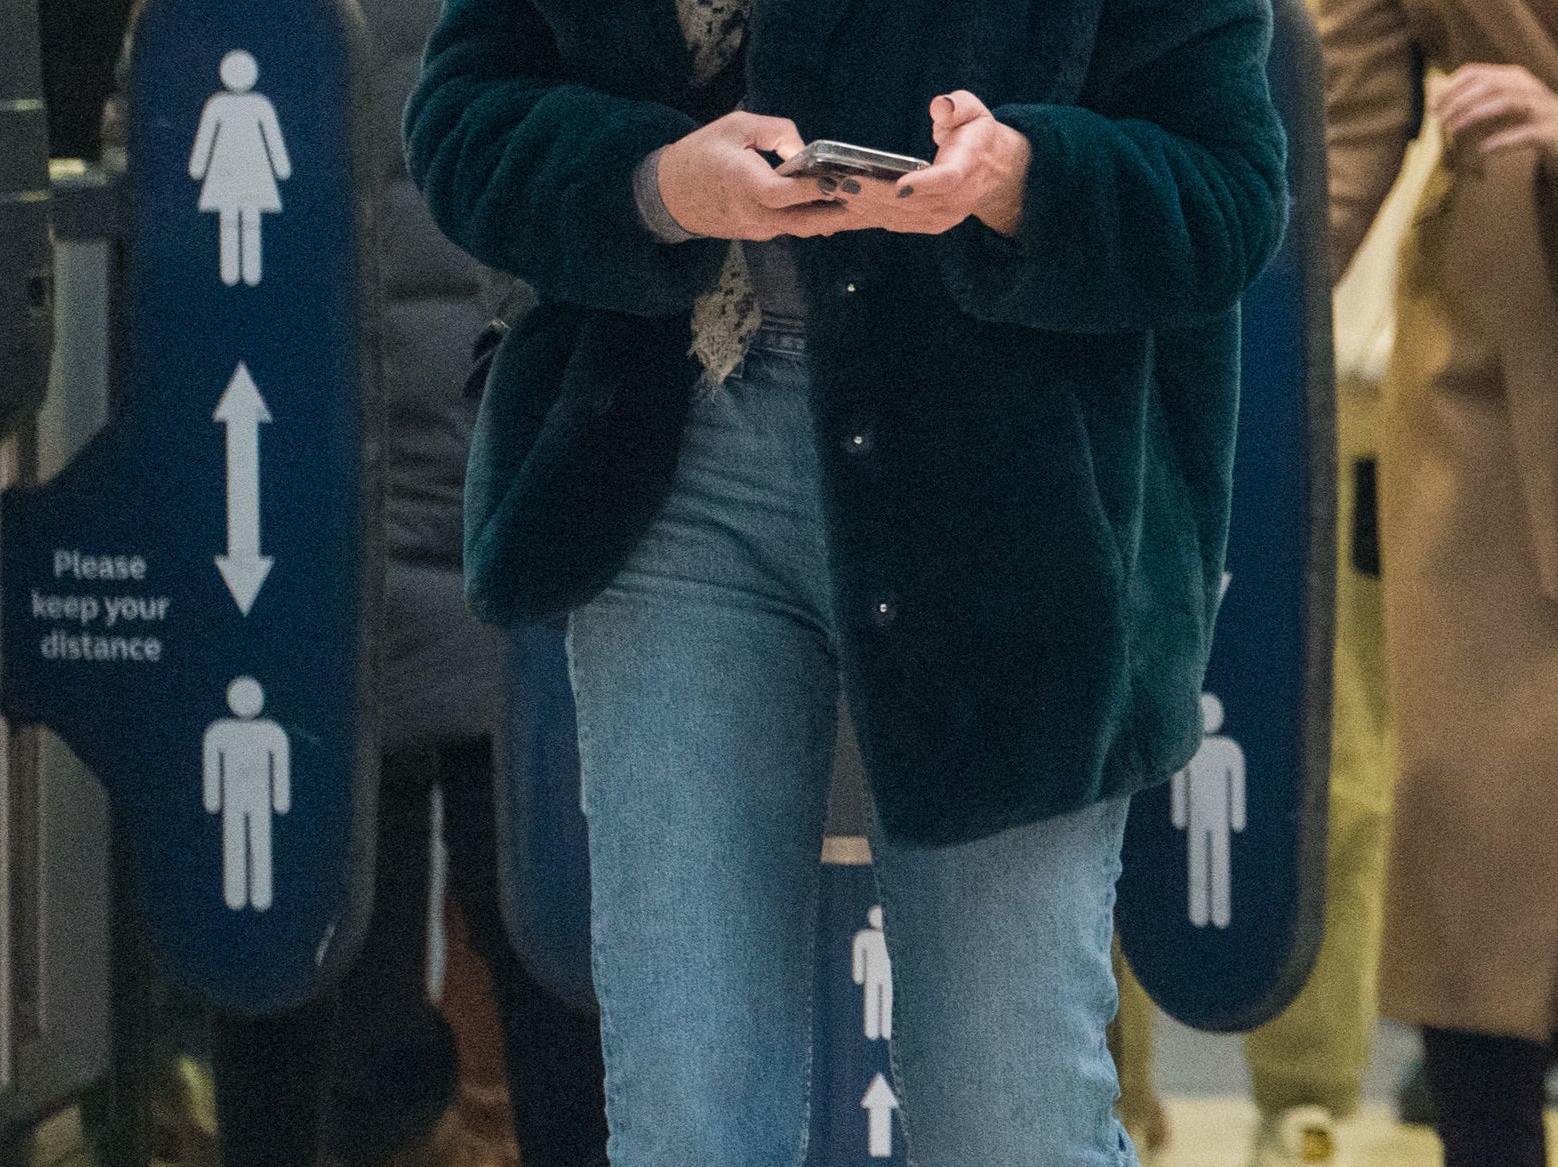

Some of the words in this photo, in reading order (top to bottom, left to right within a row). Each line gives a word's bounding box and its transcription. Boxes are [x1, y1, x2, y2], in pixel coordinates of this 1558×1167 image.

[53, 549, 147, 580] Please
[31, 590, 99, 625] keep
[104, 597, 171, 628] your
[40, 630, 162, 662] distance
